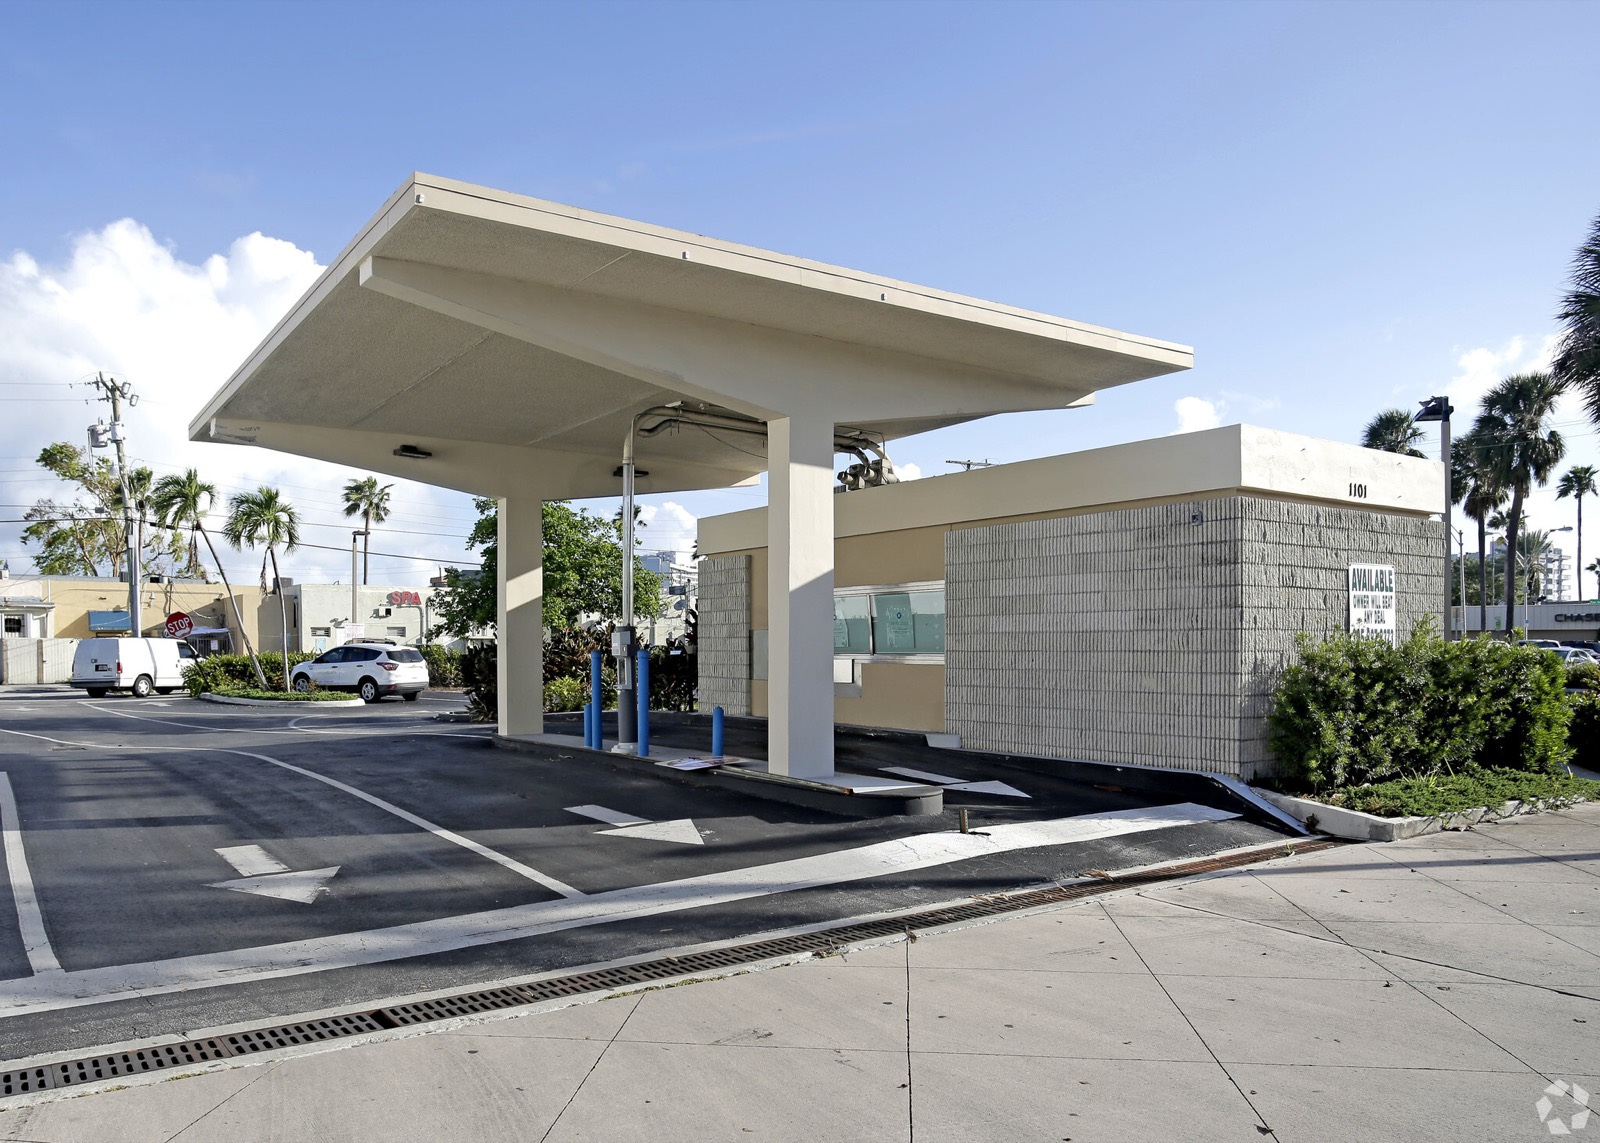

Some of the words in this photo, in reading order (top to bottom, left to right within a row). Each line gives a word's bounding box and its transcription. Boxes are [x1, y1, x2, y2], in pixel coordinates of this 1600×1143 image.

[1349, 483, 1367, 498] 1101
[1352, 568, 1393, 592] AVAILABLE
[391, 591, 422, 605] SPA
[1353, 594, 1369, 609] OWNER
[1370, 595, 1381, 609] WILL
[1364, 610, 1373, 624] ANY
[1374, 610, 1385, 624] DEAL
[1554, 613, 1600, 622] CHASE
[168, 617, 190, 633] STOP
